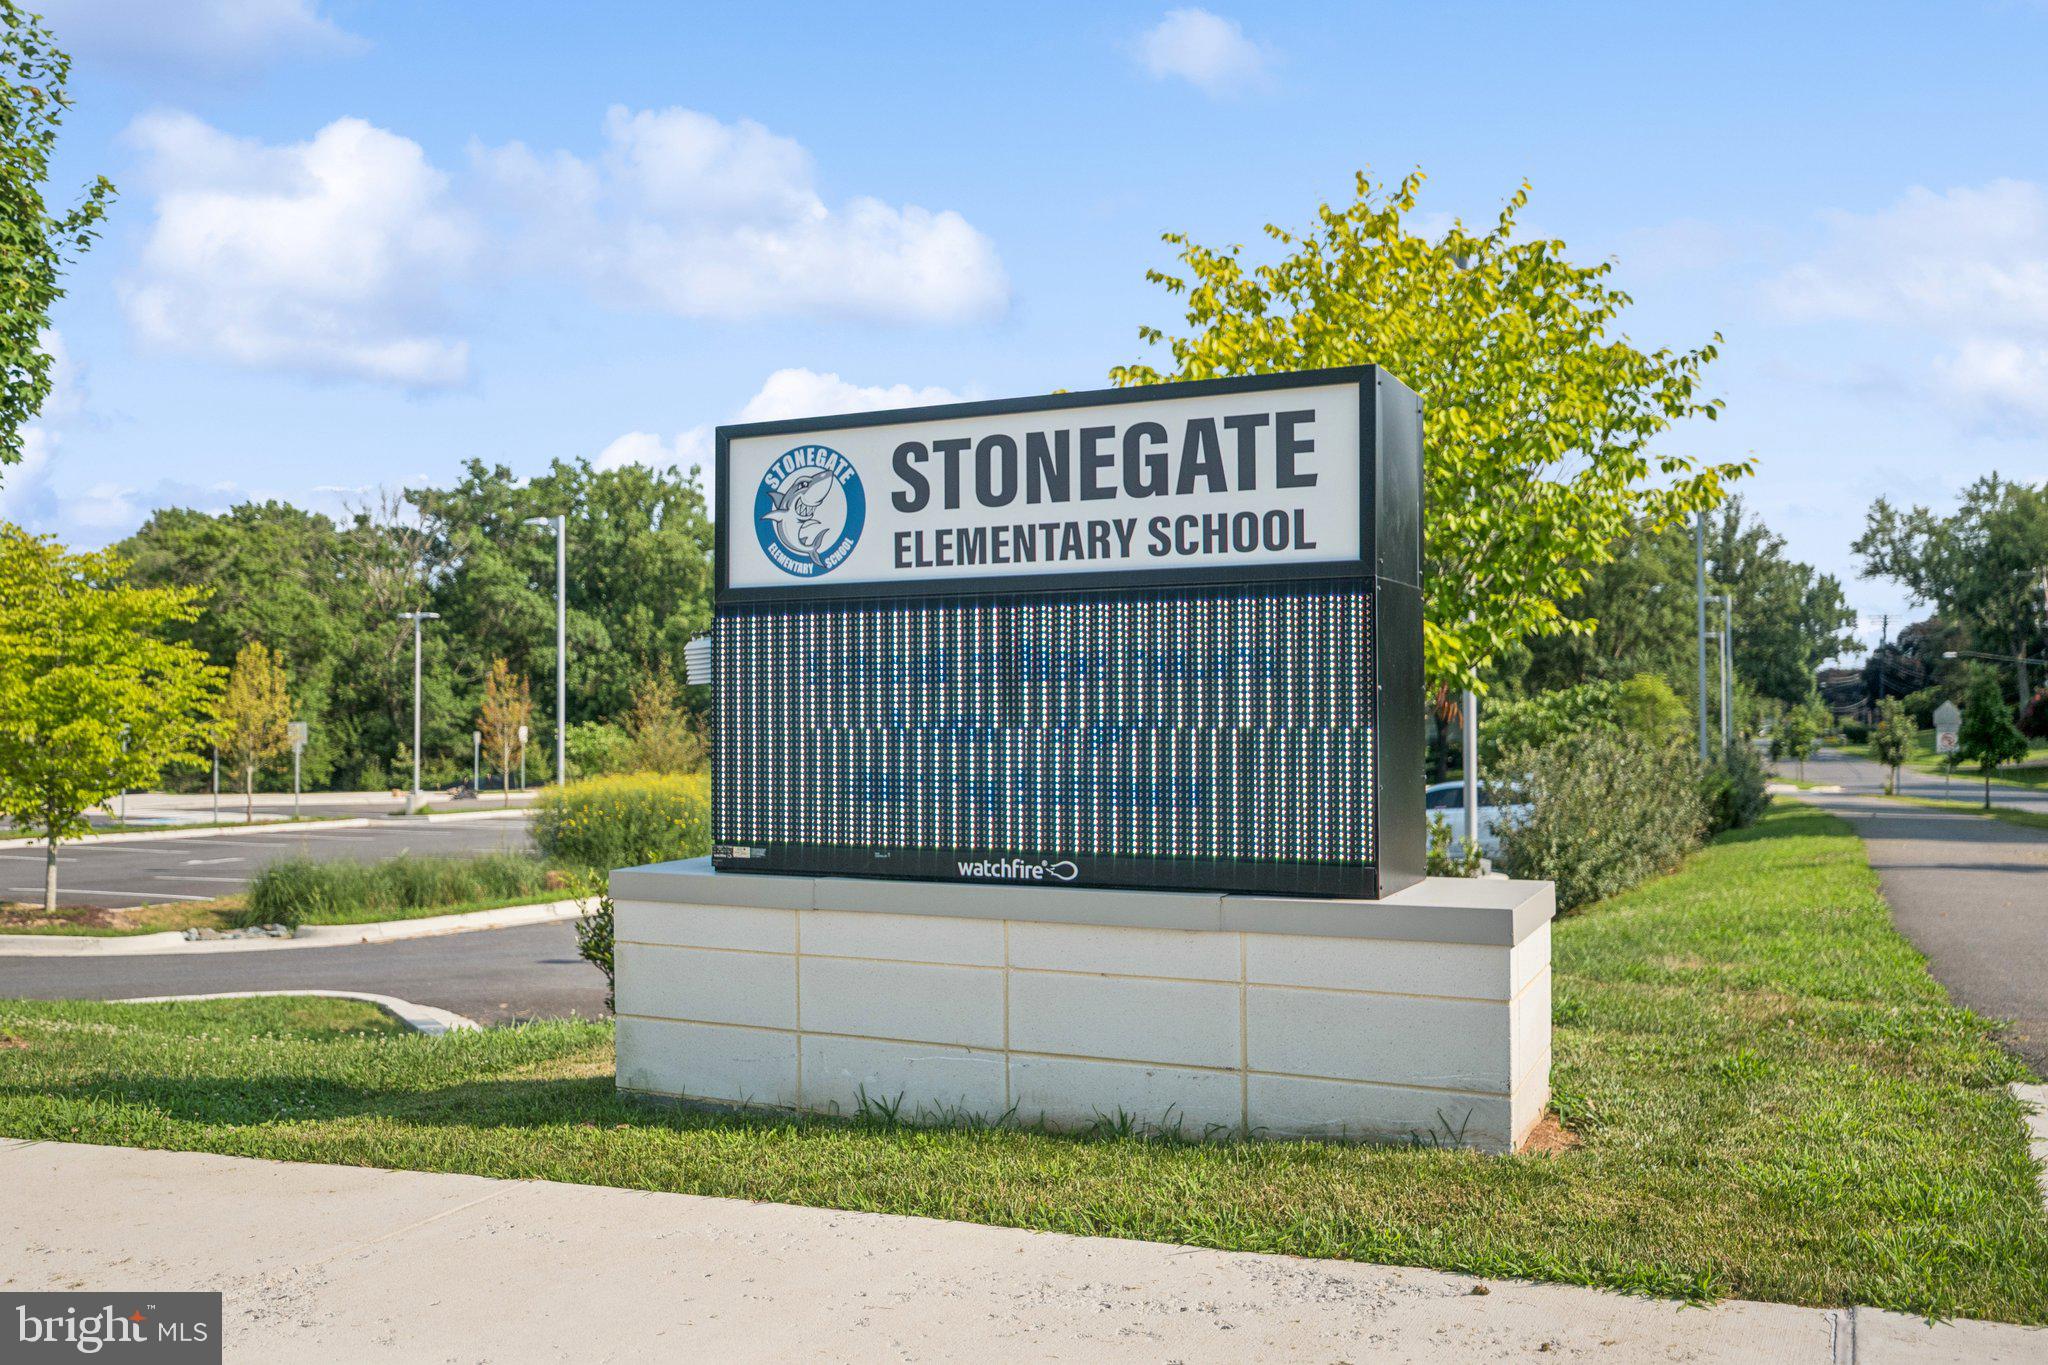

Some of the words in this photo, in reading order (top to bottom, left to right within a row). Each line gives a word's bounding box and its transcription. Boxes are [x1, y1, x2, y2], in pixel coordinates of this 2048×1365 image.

[764, 447, 855, 490] STONEGATE
[891, 409, 1318, 513] STONEGATE
[767, 542, 814, 575] ELEMENTARY
[824, 537, 855, 569] SCHOOL
[894, 518, 1137, 569] ELEMENTARY
[1147, 508, 1317, 556] SCHOOL
[957, 858, 1044, 879] watchfire
